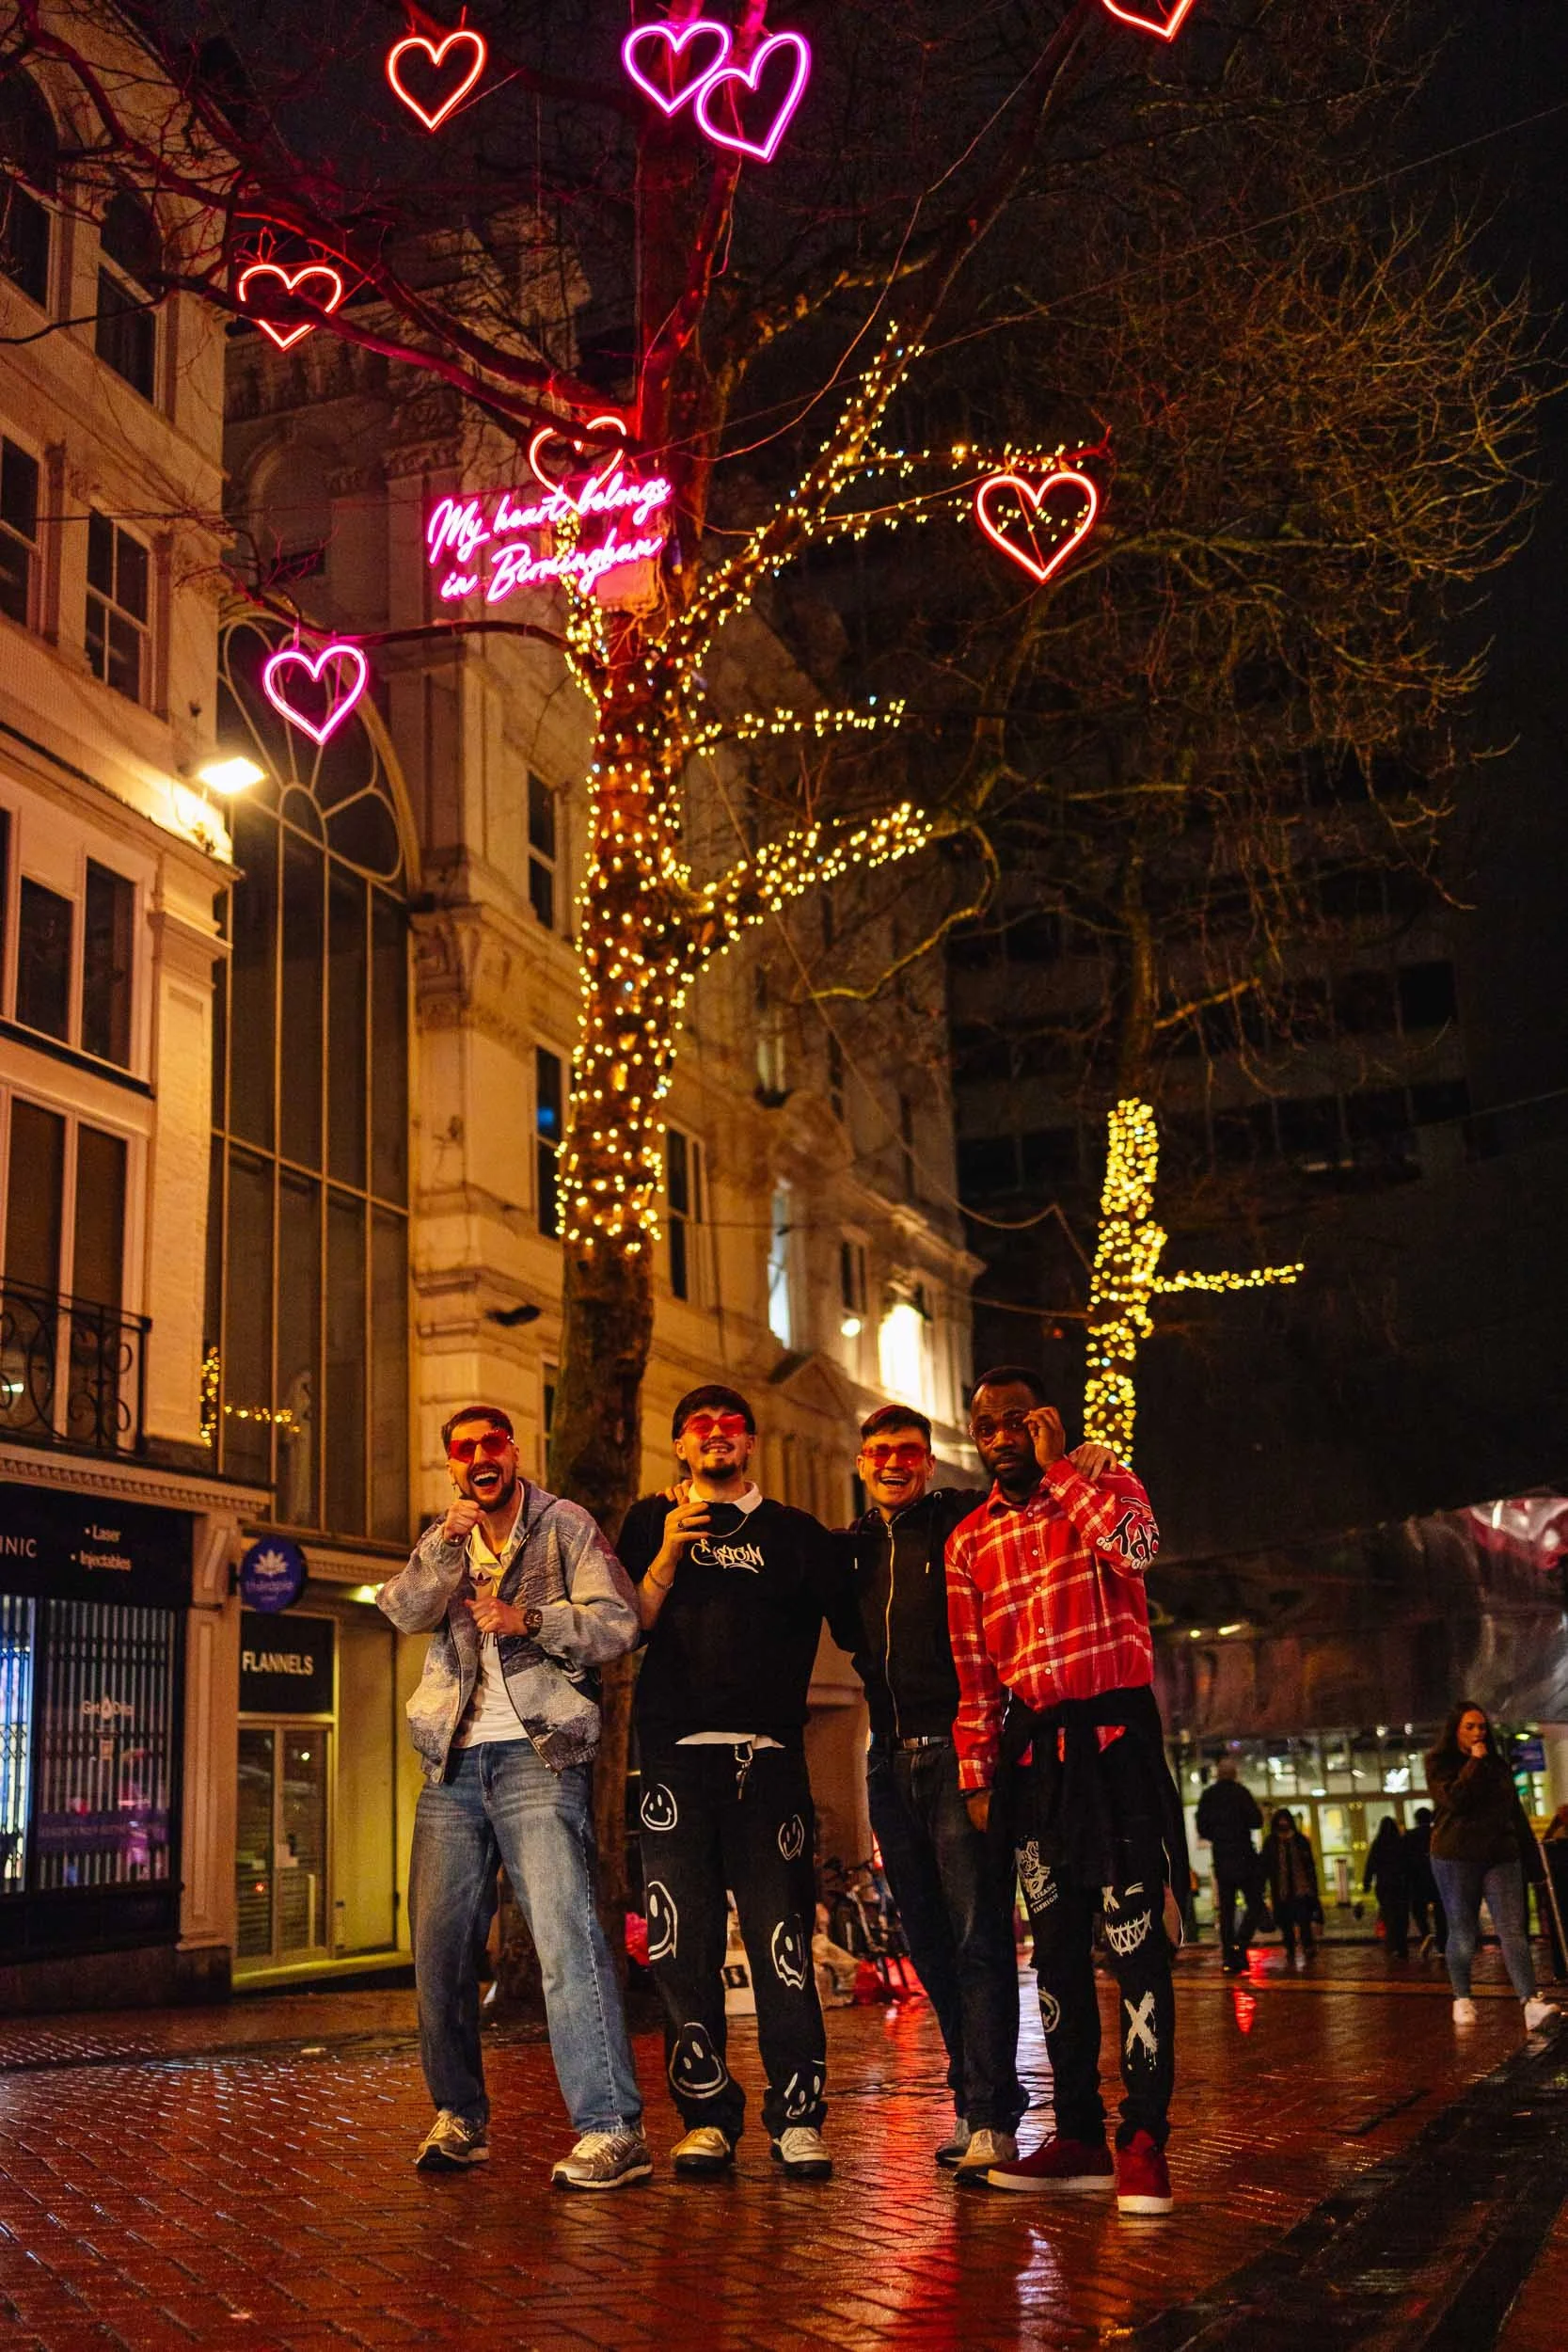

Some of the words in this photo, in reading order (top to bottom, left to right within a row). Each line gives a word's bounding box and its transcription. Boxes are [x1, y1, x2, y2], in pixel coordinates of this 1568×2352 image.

[427, 499, 490, 564] My
[493, 485, 569, 535] heart
[577, 472, 672, 526] belongs
[440, 572, 478, 599] in
[487, 528, 663, 603] Birmingham
[242, 1650, 315, 1677] FLANNELS
